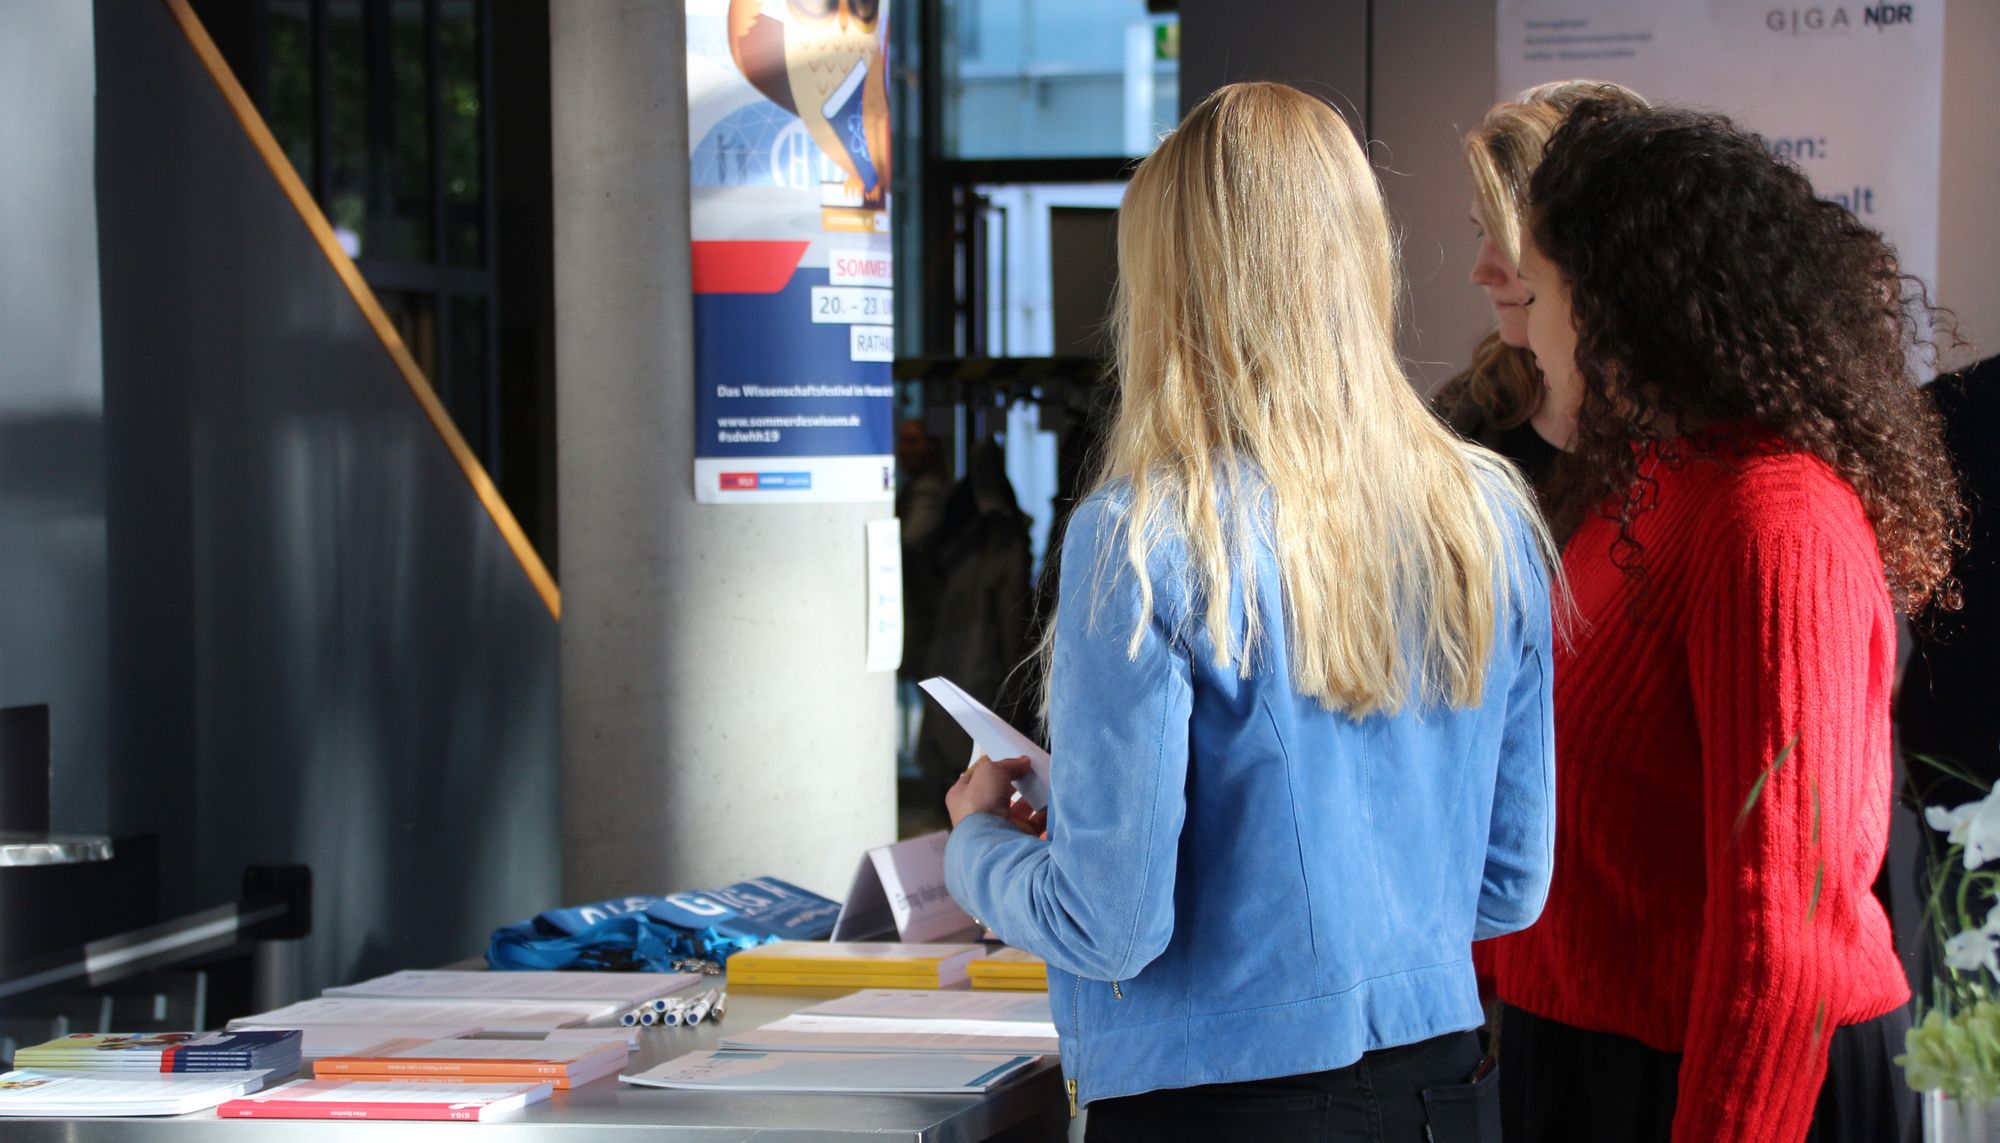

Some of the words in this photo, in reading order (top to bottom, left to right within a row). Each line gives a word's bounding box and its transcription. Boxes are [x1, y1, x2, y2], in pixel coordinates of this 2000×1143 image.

[1864, 5, 1913, 27] NDR
[819, 296, 846, 315] 20.
[716, 385, 741, 398] Das
[742, 384, 853, 398] Wissenschaftsfestival
[718, 429, 781, 443] #sdwhh19
[537, 1066, 557, 1074] GIGA
